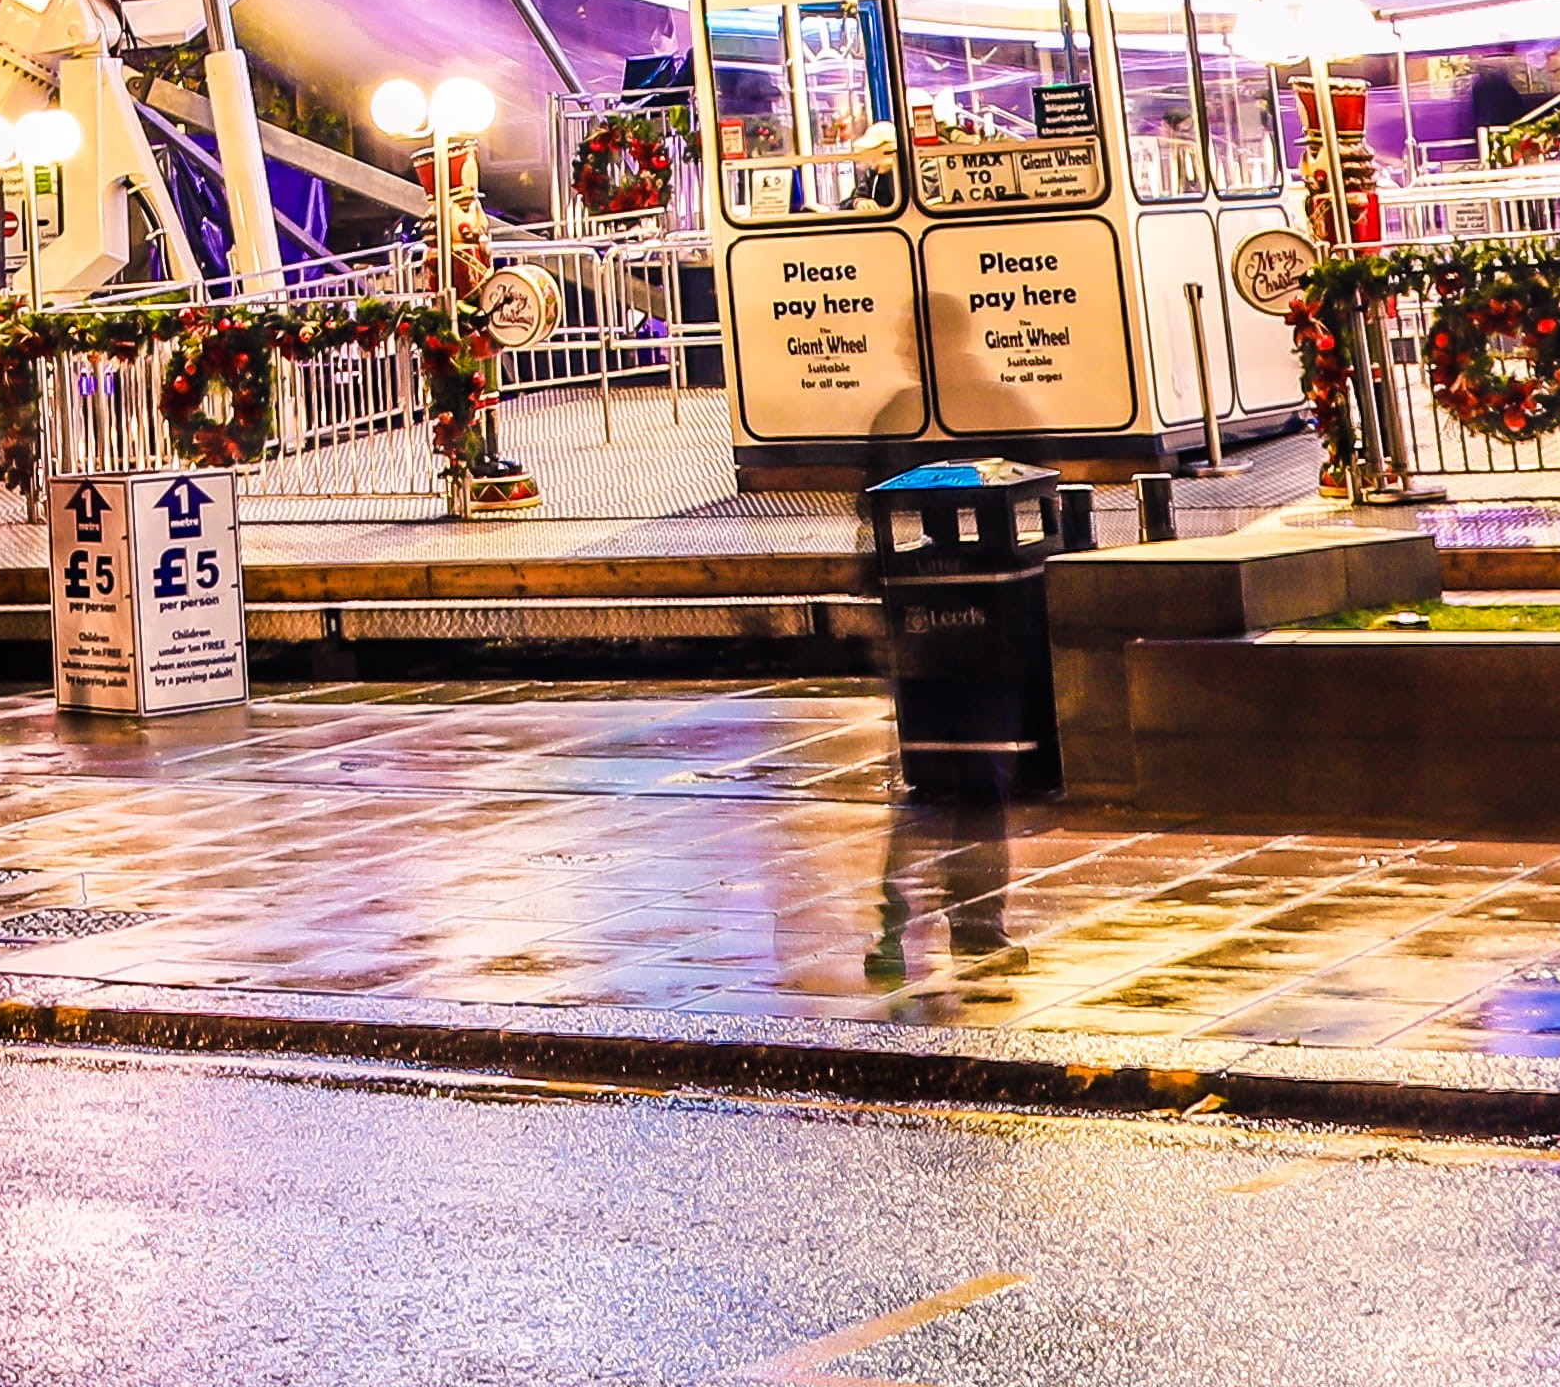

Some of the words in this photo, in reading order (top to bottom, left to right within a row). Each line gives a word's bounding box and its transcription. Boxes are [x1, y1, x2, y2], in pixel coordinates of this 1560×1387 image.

[946, 157, 957, 170] 6
[962, 154, 1004, 169] MAX
[1020, 154, 1053, 170] Giant
[1054, 150, 1092, 167] Wheel
[966, 170, 992, 184] TO
[951, 189, 965, 203] A
[783, 261, 857, 283] Please
[979, 251, 1058, 275] Please
[773, 299, 816, 320] pay
[823, 293, 874, 314] here
[969, 291, 1016, 313] pay
[1022, 284, 1077, 306] here
[787, 339, 825, 356] Giant
[826, 336, 868, 354] Wheel
[984, 330, 1024, 349] Giant
[1027, 327, 1071, 347] Wheel
[807, 362, 851, 374] Suitable
[1006, 355, 1054, 368] Suitable
[800, 379, 817, 389] for
[818, 378, 833, 388] all
[835, 379, 860, 390] ages
[1000, 372, 1017, 383] for
[1018, 371, 1034, 382] all
[1036, 372, 1063, 383] ages
[81, 488, 92, 518] 1
[174, 483, 189, 514] 1
[78, 522, 100, 531] metre
[170, 517, 199, 528] metre
[69, 601, 84, 614] per
[85, 601, 117, 613] person
[159, 601, 179, 613] per
[180, 595, 220, 611] person
[930, 607, 985, 626] Leeds
[171, 628, 211, 640] Children
[159, 645, 186, 657] under
[202, 640, 226, 651] FREE
[149, 661, 175, 672] when
[176, 652, 237, 669] accompanied
[155, 676, 168, 687] by
[175, 671, 207, 686] paying
[209, 667, 233, 679] adult
